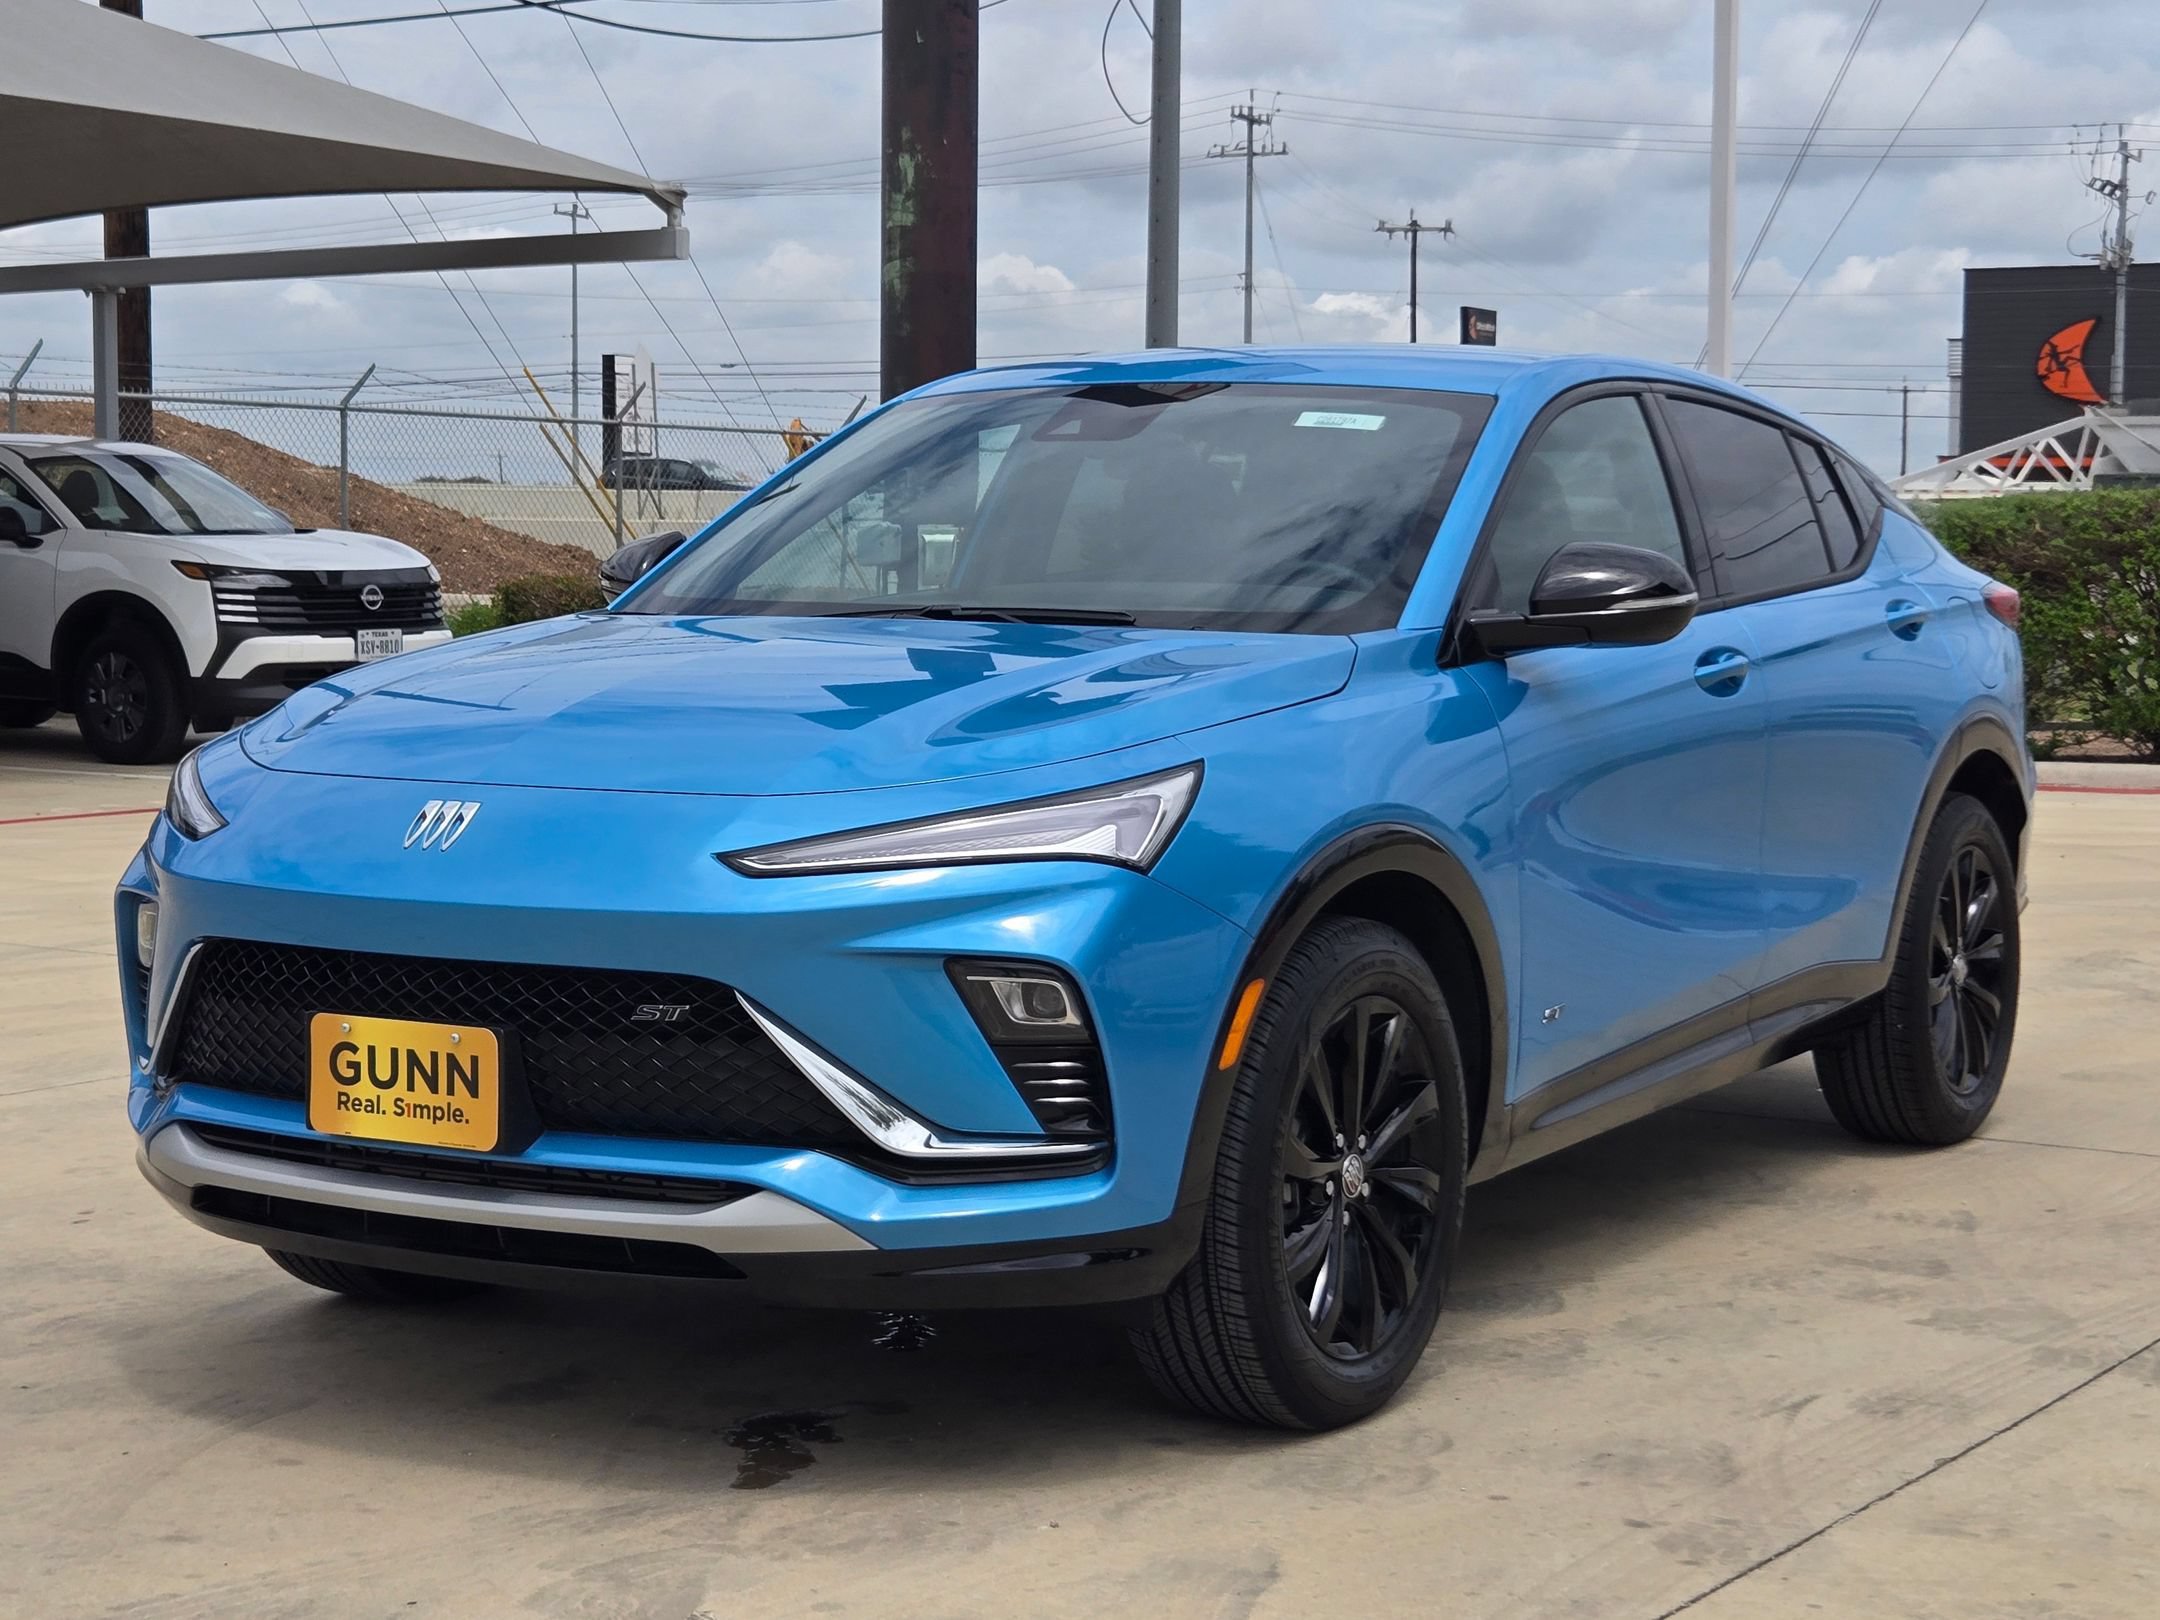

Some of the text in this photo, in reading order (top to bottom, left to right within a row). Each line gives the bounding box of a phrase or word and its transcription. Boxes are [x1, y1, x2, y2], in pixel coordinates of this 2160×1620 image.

[630, 1004, 690, 1021] ST
[329, 1041, 479, 1099] GUNN
[337, 1091, 387, 1116] Real.
